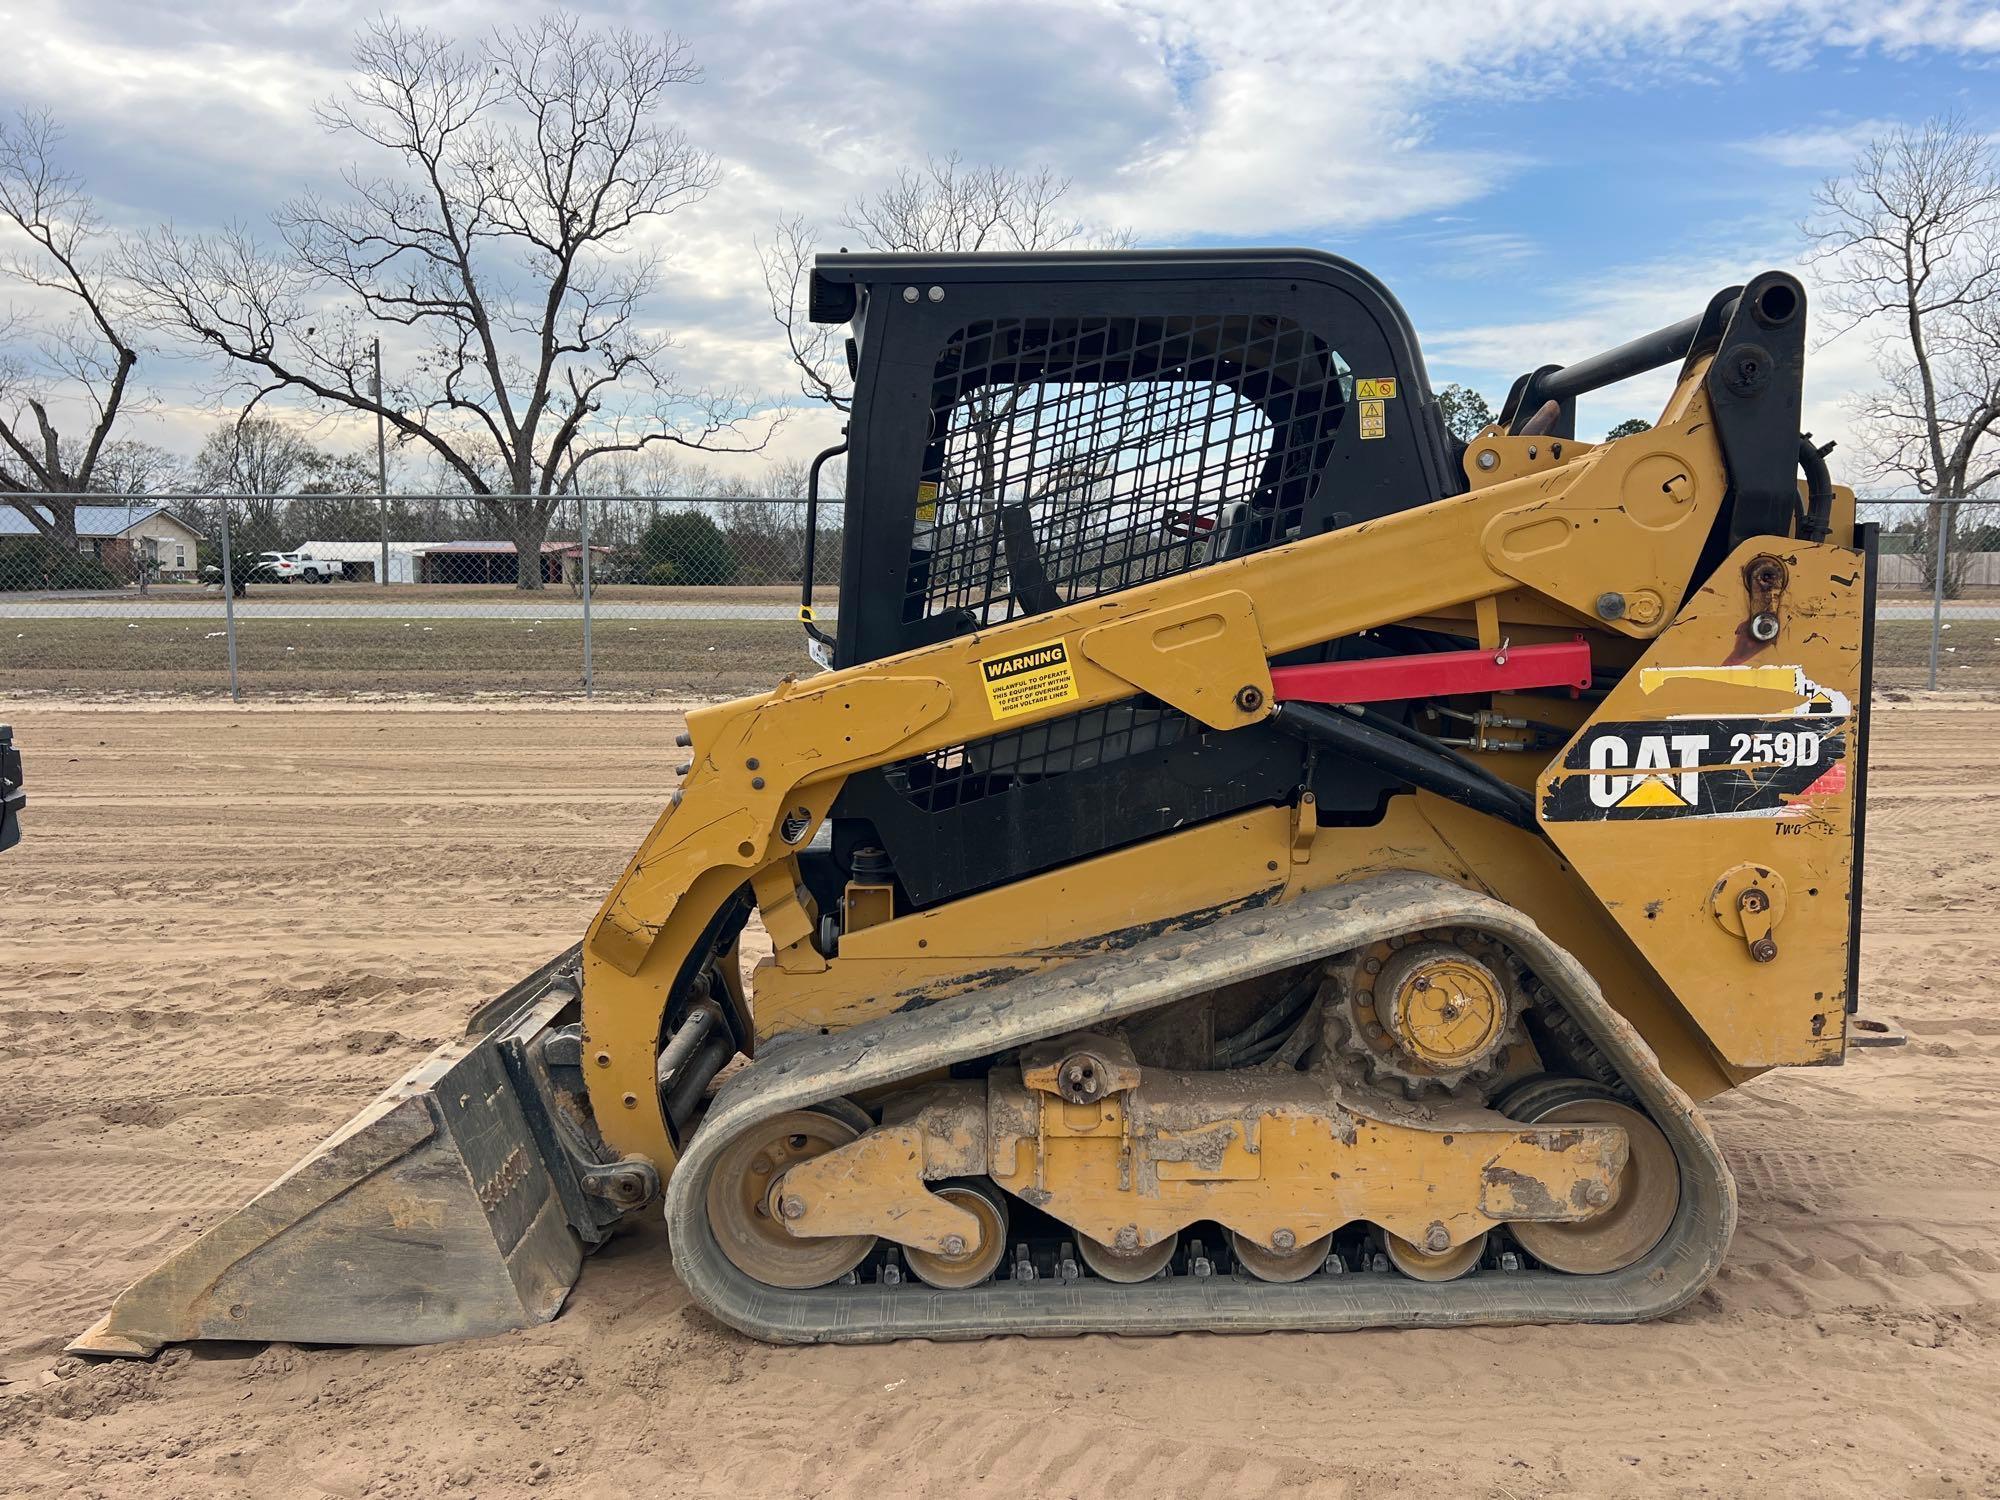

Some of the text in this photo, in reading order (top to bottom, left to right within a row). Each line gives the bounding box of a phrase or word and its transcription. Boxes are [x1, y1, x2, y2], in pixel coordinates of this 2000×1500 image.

[987, 648, 1063, 677] WARNING
[992, 681, 1027, 693] UNLAWFUL
[1039, 670, 1068, 681] OPERATE
[993, 676, 1071, 700] THIS EQUIPMENT WITHIN
[1002, 690, 1068, 712] HIGH VOLTAGE LINES
[1007, 695, 1023, 704] FEET
[1035, 684, 1069, 696] OVERHEAD
[1589, 732, 1820, 808] CAT 259D
